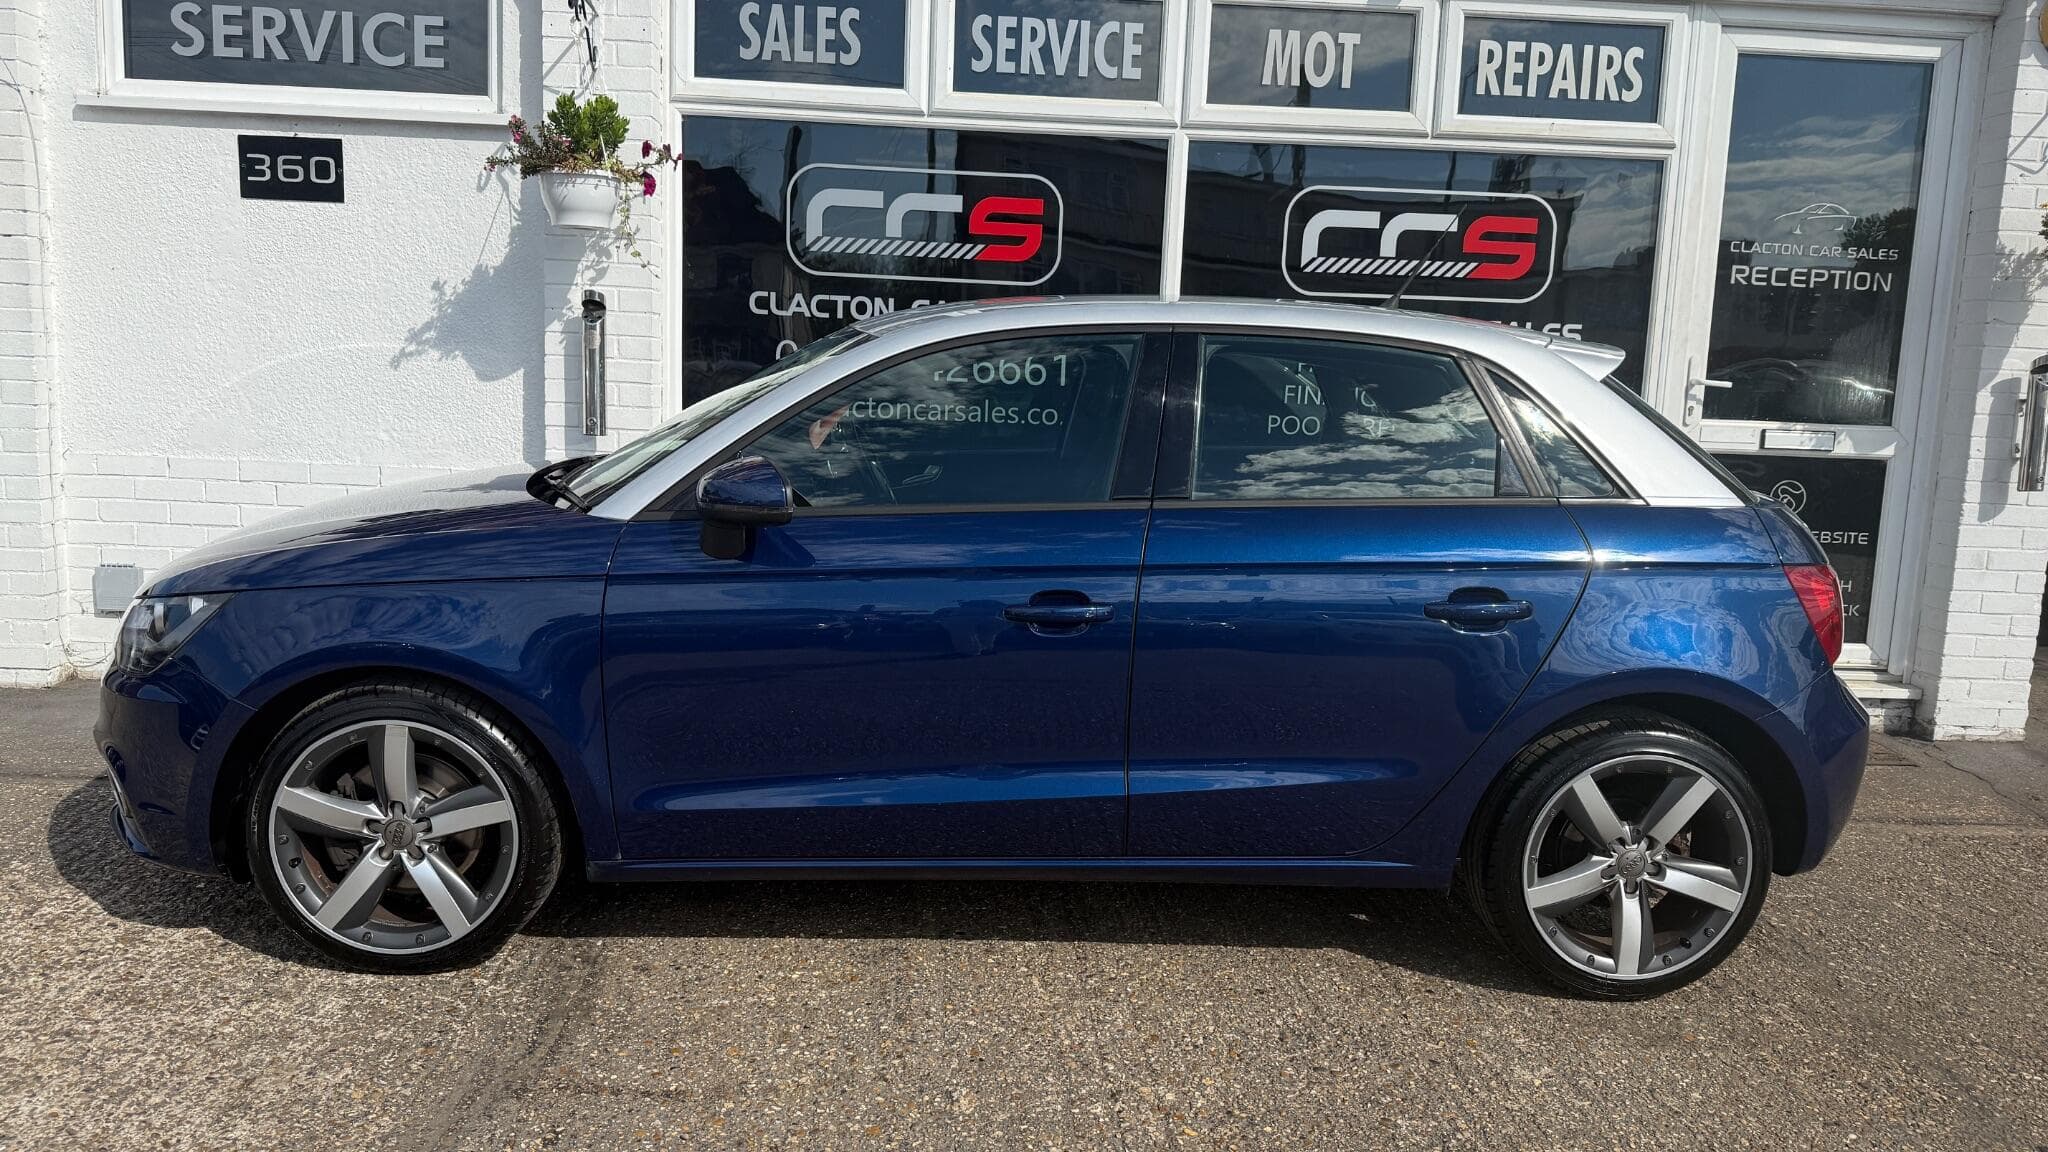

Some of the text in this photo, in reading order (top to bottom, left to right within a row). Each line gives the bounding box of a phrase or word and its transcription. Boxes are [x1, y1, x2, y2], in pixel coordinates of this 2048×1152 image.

[170, 1, 445, 68] SERVICE
[738, 1, 862, 66] SALES
[971, 14, 1144, 80] SERVICE
[1261, 29, 1361, 89] MOT
[1475, 39, 1645, 103] REPAIRS
[246, 153, 336, 185] 360
[1730, 241, 1899, 261] CLACTON CAR SALES
[1730, 265, 1893, 292] RECEPTION
[748, 291, 895, 321] CLACTON
